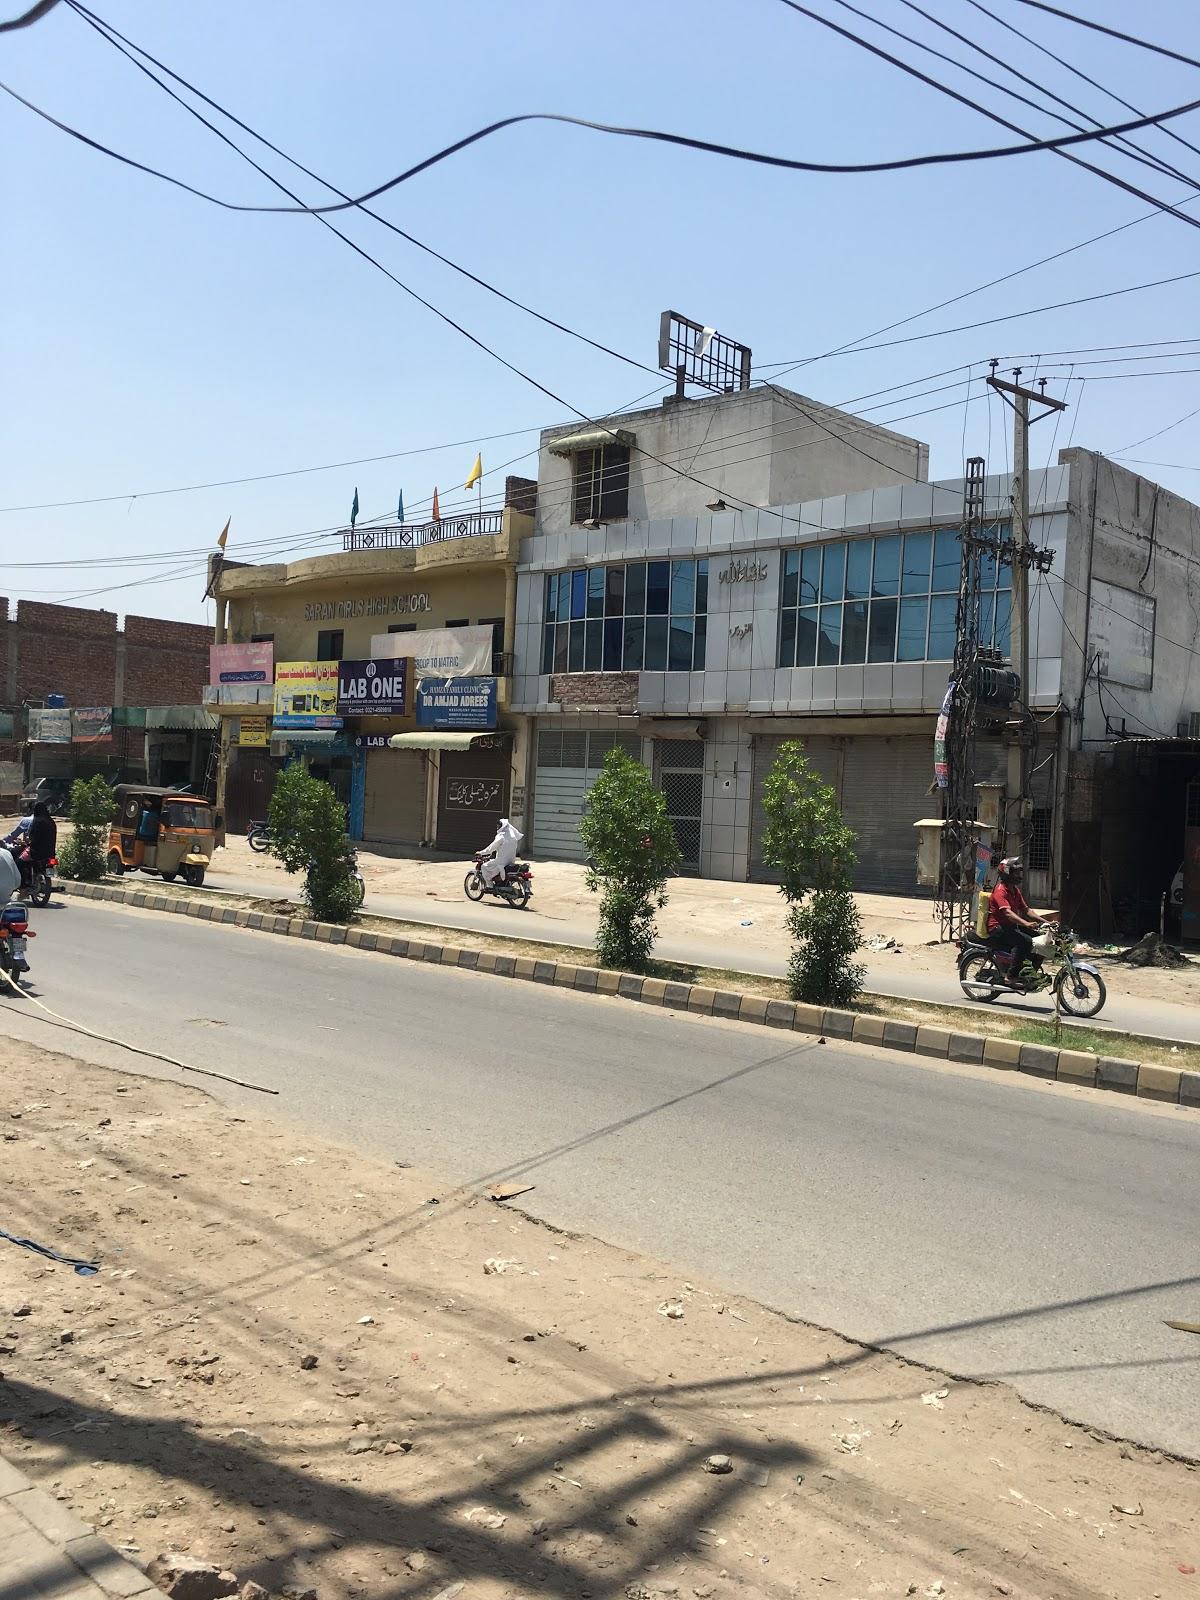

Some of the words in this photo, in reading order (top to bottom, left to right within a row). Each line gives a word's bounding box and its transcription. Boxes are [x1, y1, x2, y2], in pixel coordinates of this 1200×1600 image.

[338, 599, 364, 619] GIRLS
[366, 596, 389, 616] HIGH
[391, 592, 432, 615] SCHOOL
[340, 678, 367, 699] LAB
[371, 676, 403, 698] ONE
[423, 695, 433, 706] DR
[434, 695, 459, 706] AMJAD
[460, 695, 488, 707] ADREES
[367, 736, 385, 746] LAB
